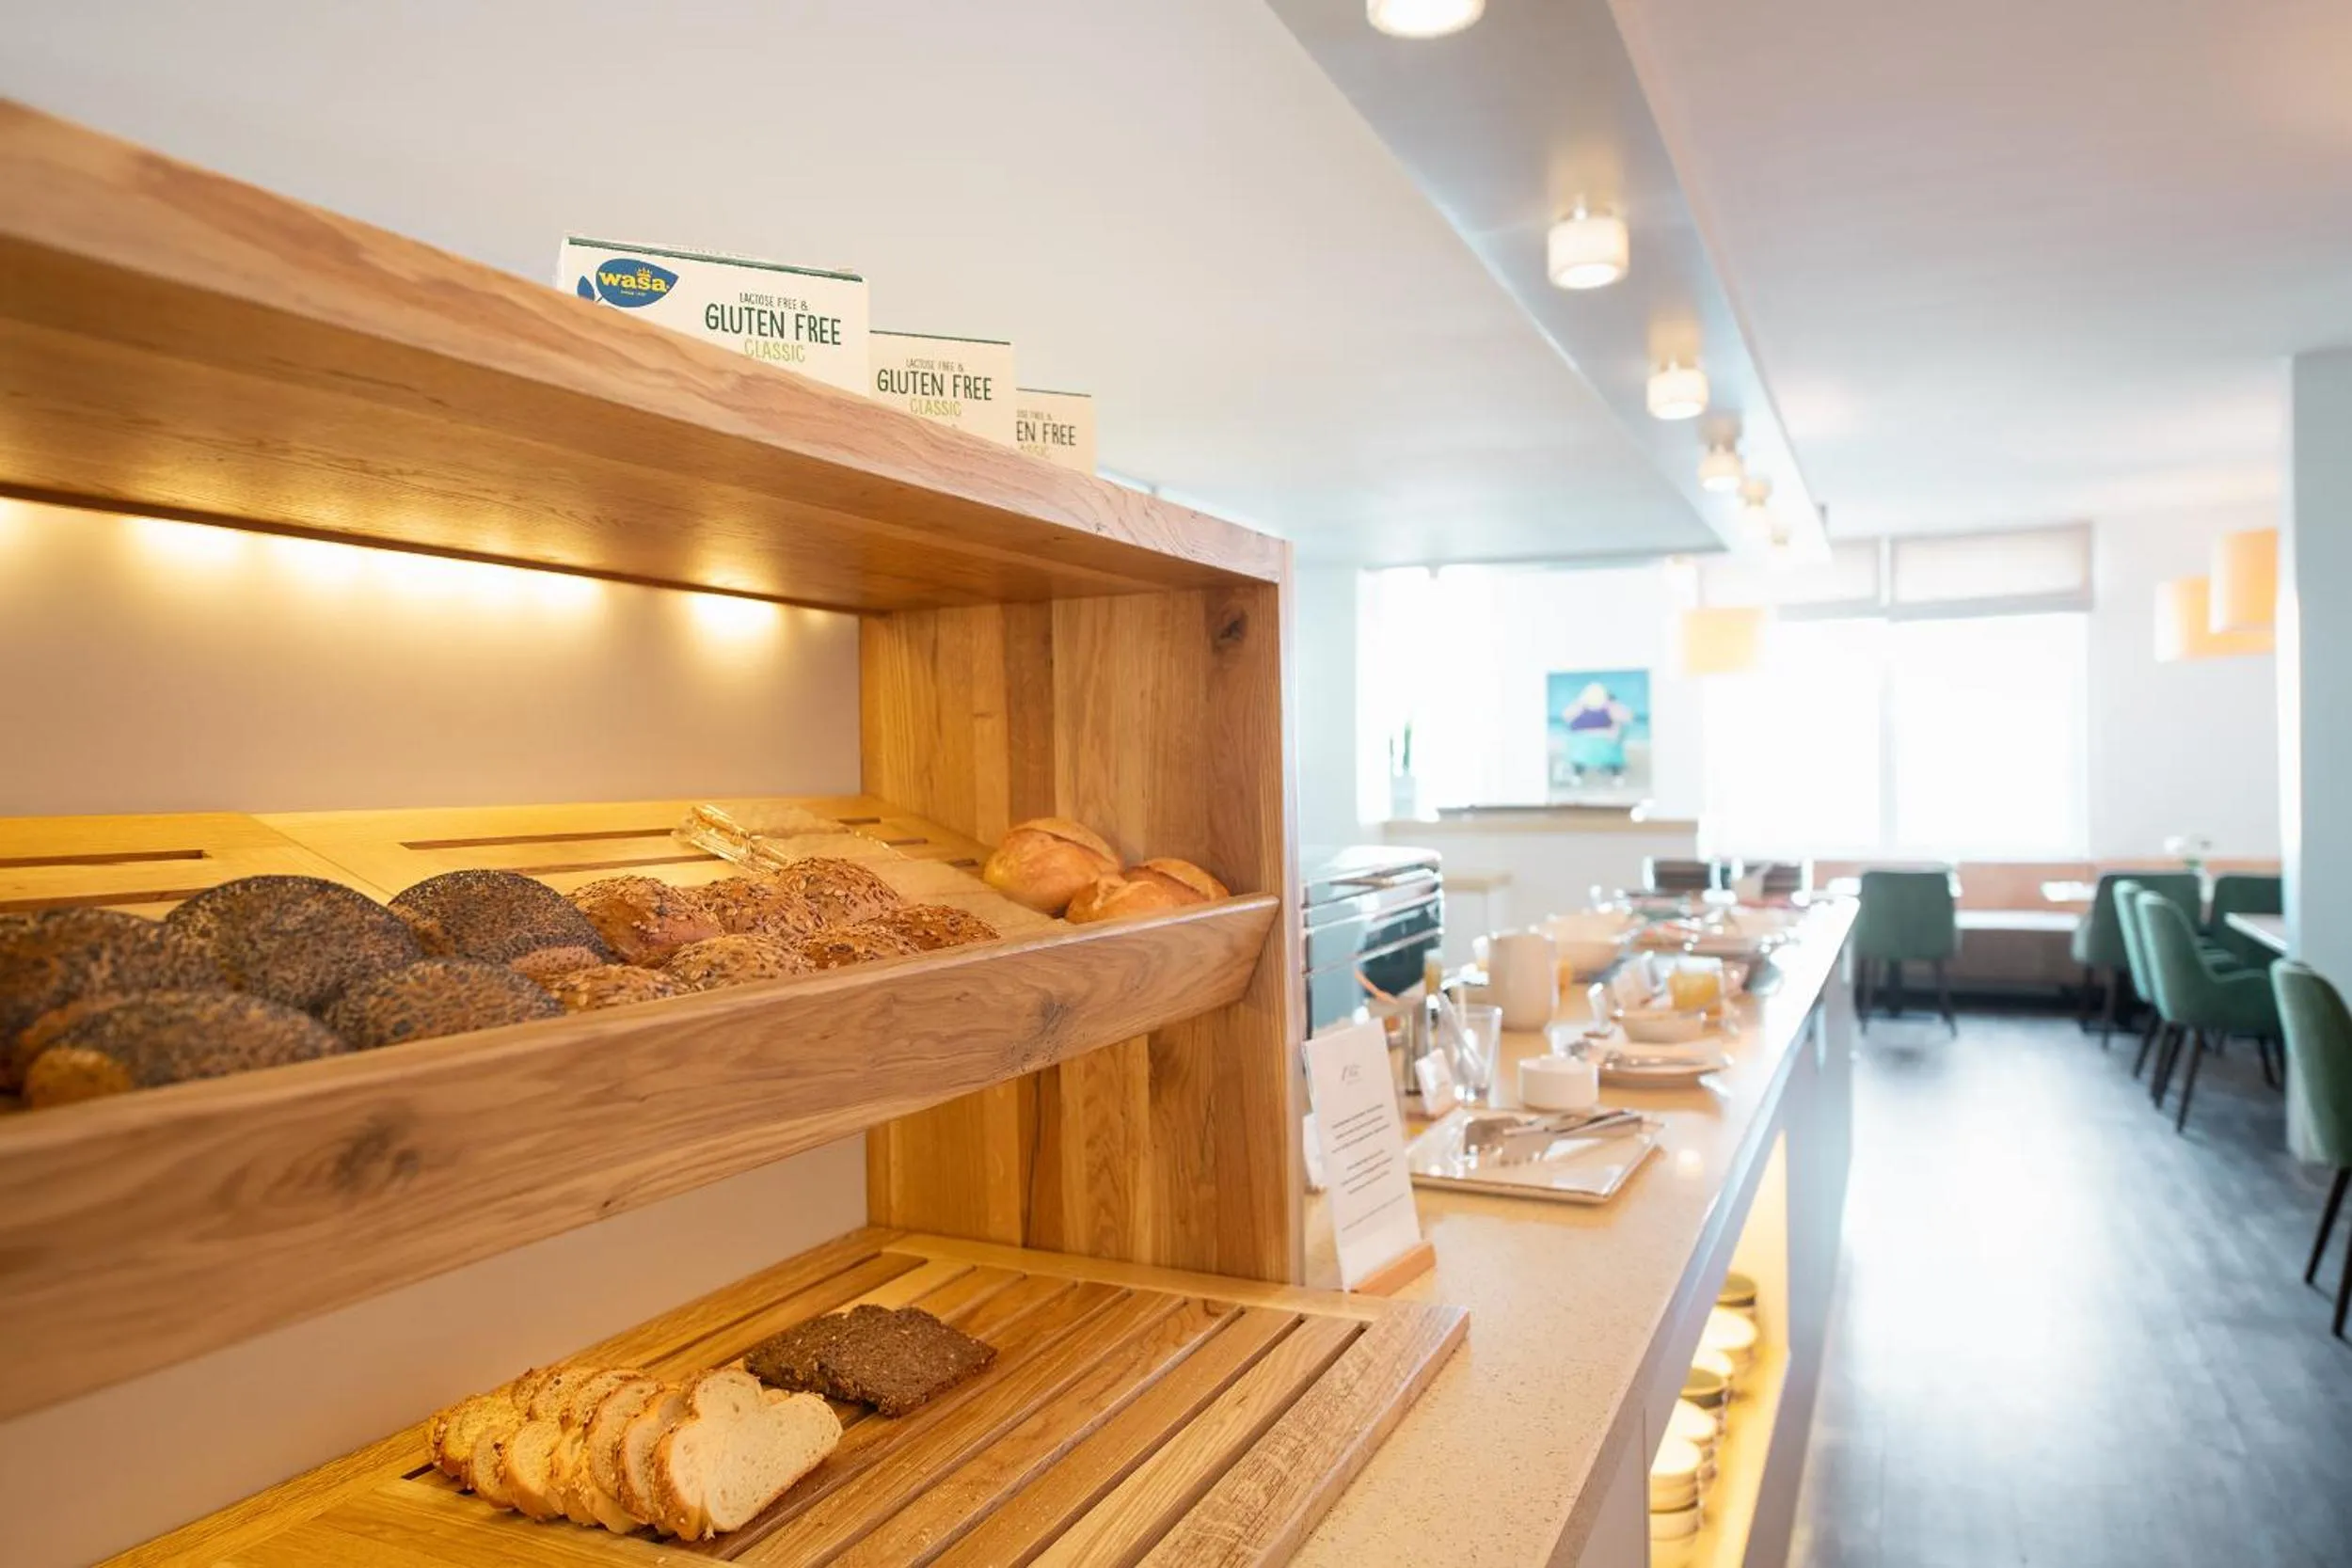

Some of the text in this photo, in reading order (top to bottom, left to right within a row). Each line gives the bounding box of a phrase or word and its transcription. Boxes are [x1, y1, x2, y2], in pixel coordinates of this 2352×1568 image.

[598, 271, 667, 293] wasa
[739, 292, 808, 311] LACTOSE FREE &
[705, 303, 842, 345] GLUTEN FREE
[743, 339, 805, 363] CLASSIC
[877, 368, 993, 401] GLUTEN FREE
[910, 397, 961, 418] CLASSIC
[1042, 422, 1076, 446] FREE
